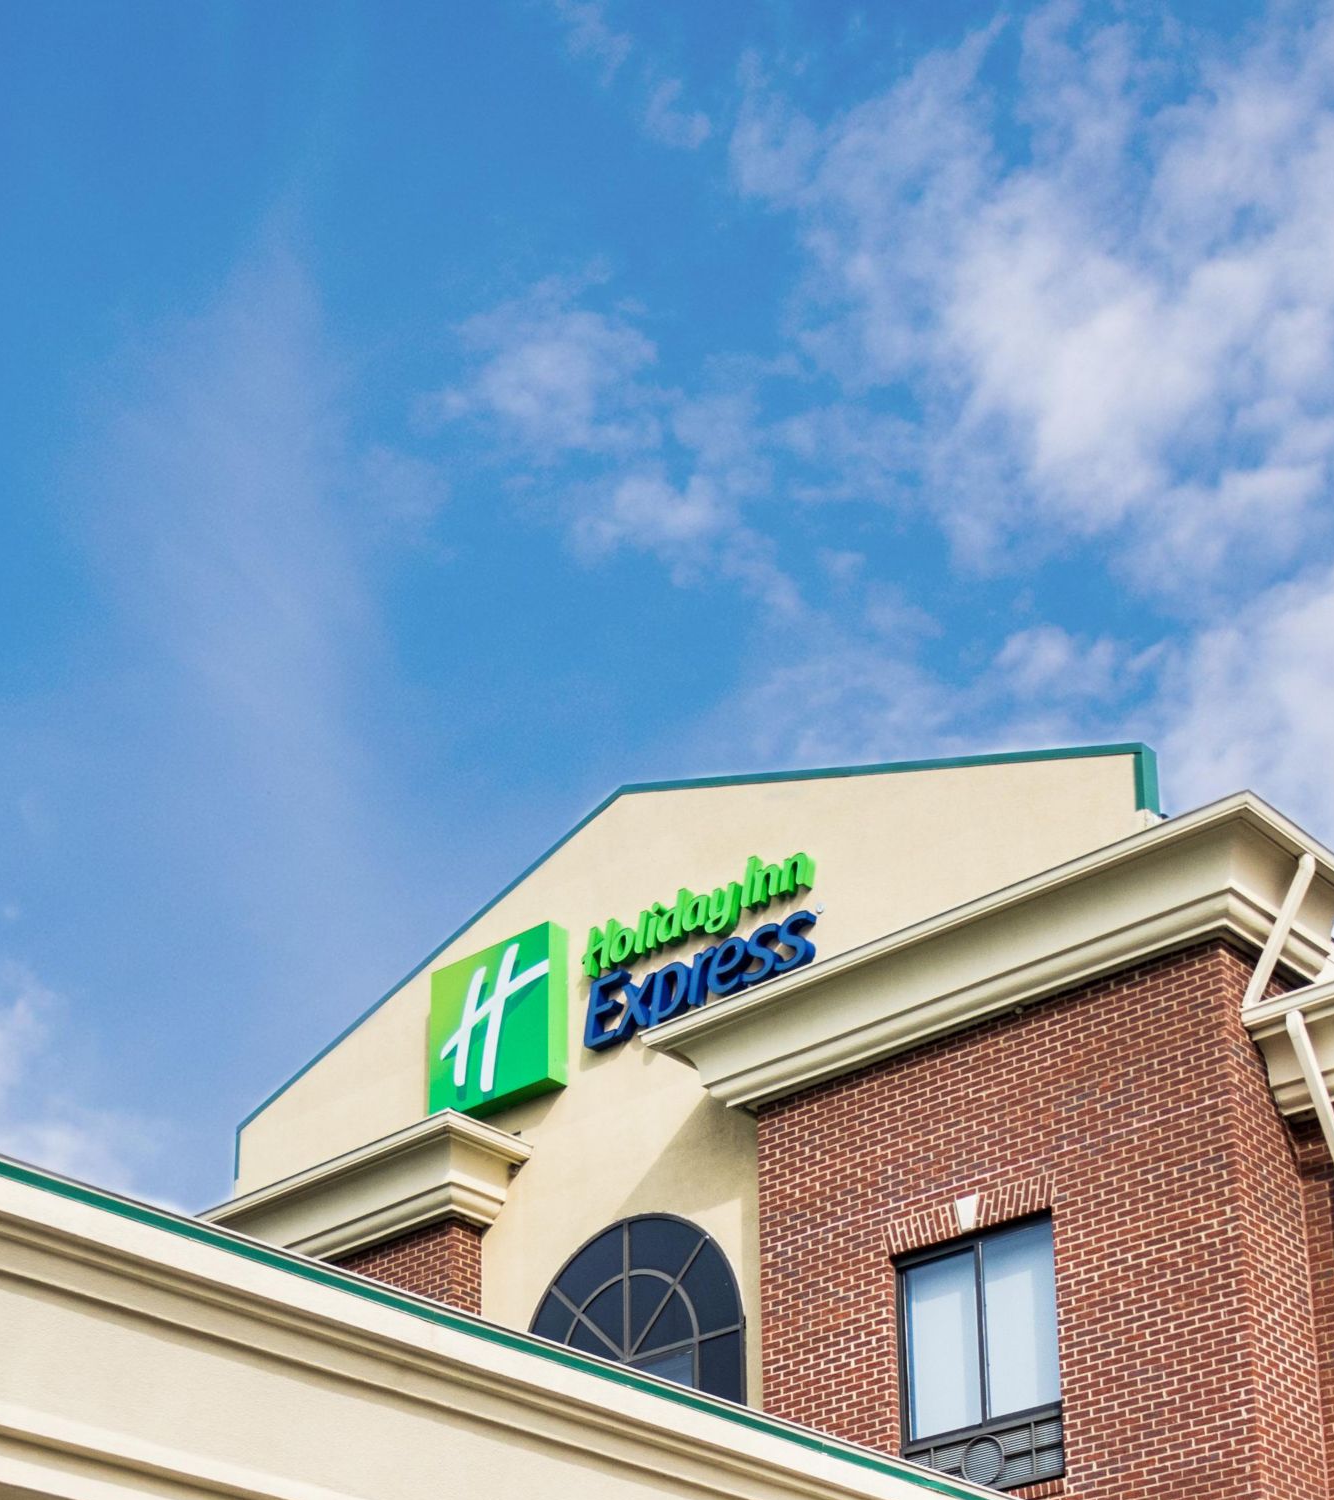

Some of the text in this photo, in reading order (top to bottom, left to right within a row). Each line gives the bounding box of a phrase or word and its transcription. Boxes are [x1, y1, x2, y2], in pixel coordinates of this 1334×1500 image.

[582, 852, 816, 979] Holiday Inn
[584, 910, 817, 1050] Express
